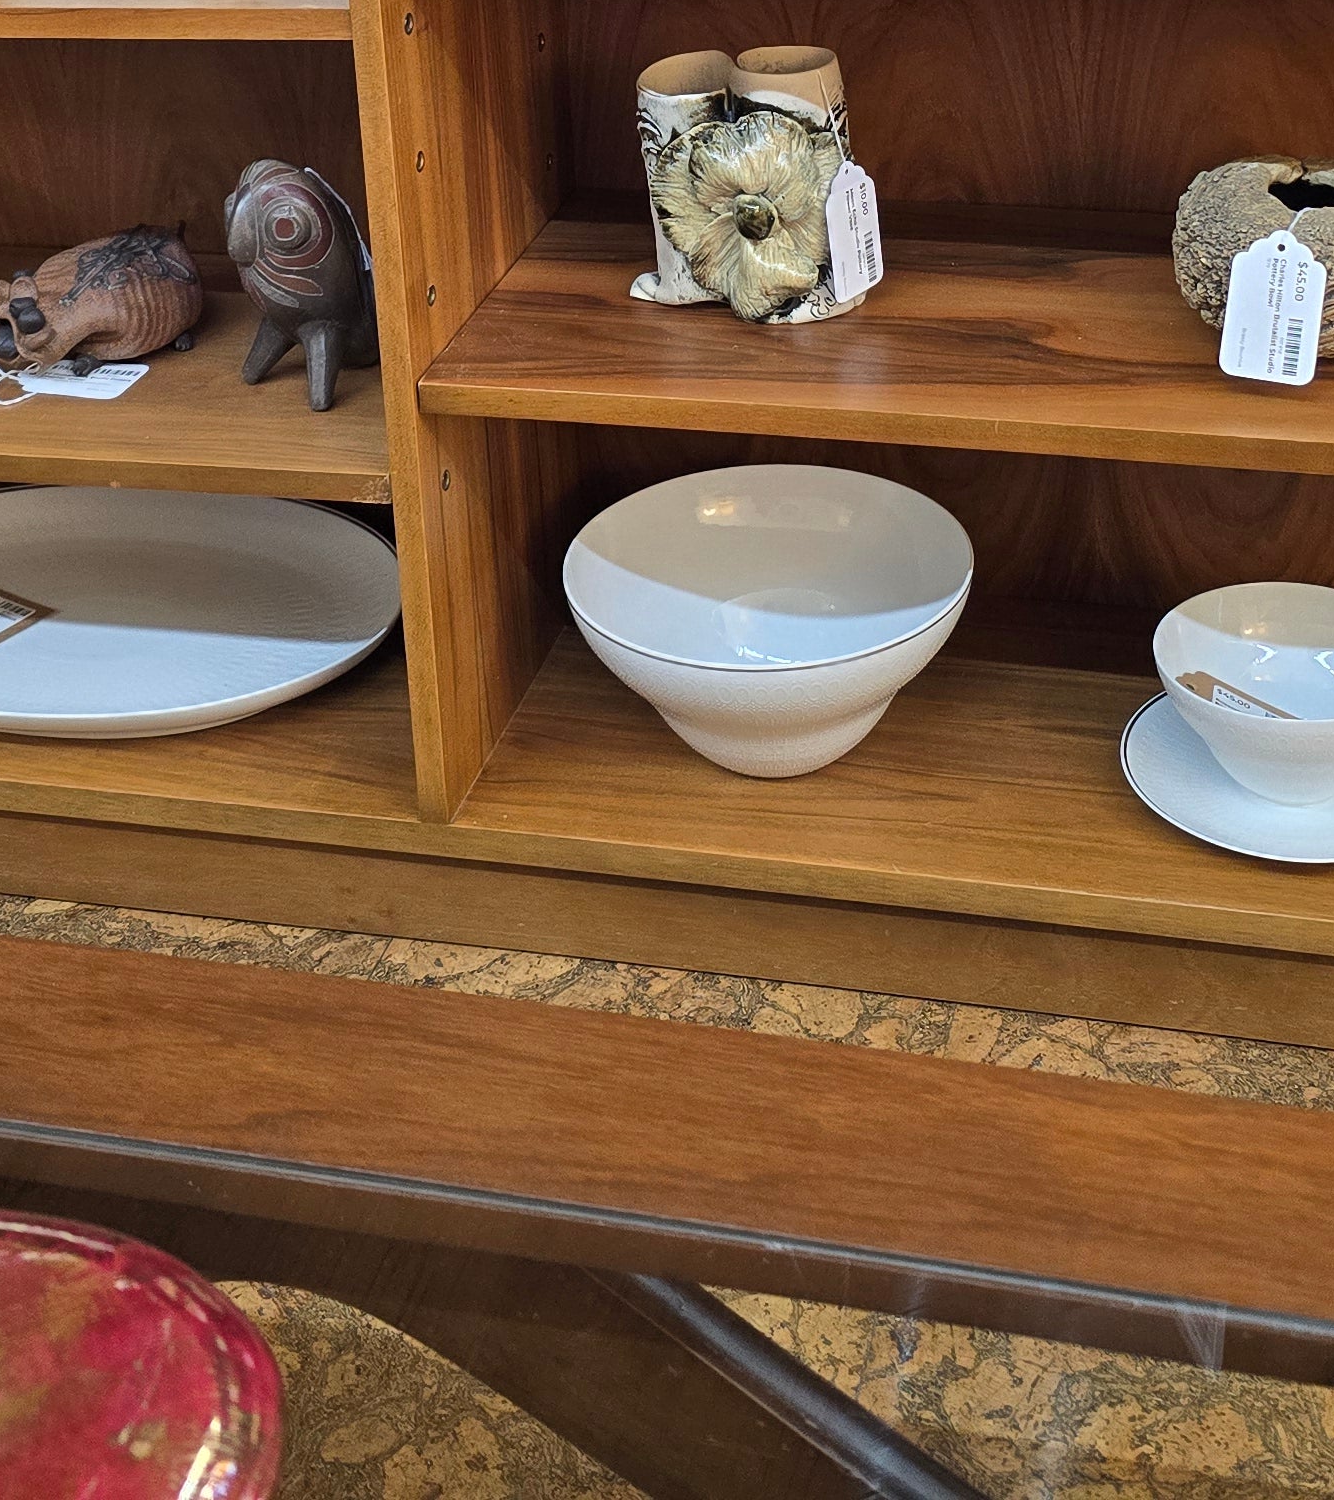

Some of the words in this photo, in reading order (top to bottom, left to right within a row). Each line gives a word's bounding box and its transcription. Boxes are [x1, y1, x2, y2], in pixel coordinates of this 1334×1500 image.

[858, 181, 869, 217] $10.00
[1267, 256, 1279, 286] Pottery
[1276, 258, 1288, 288] Charles
[1292, 260, 1309, 302] $45.00
[1266, 287, 1275, 308] Bowl
[1273, 288, 1283, 313] Hilton
[1269, 313, 1280, 347] Brutalist
[1265, 347, 1277, 374] Studio
[1216, 688, 1251, 710] $45.00
